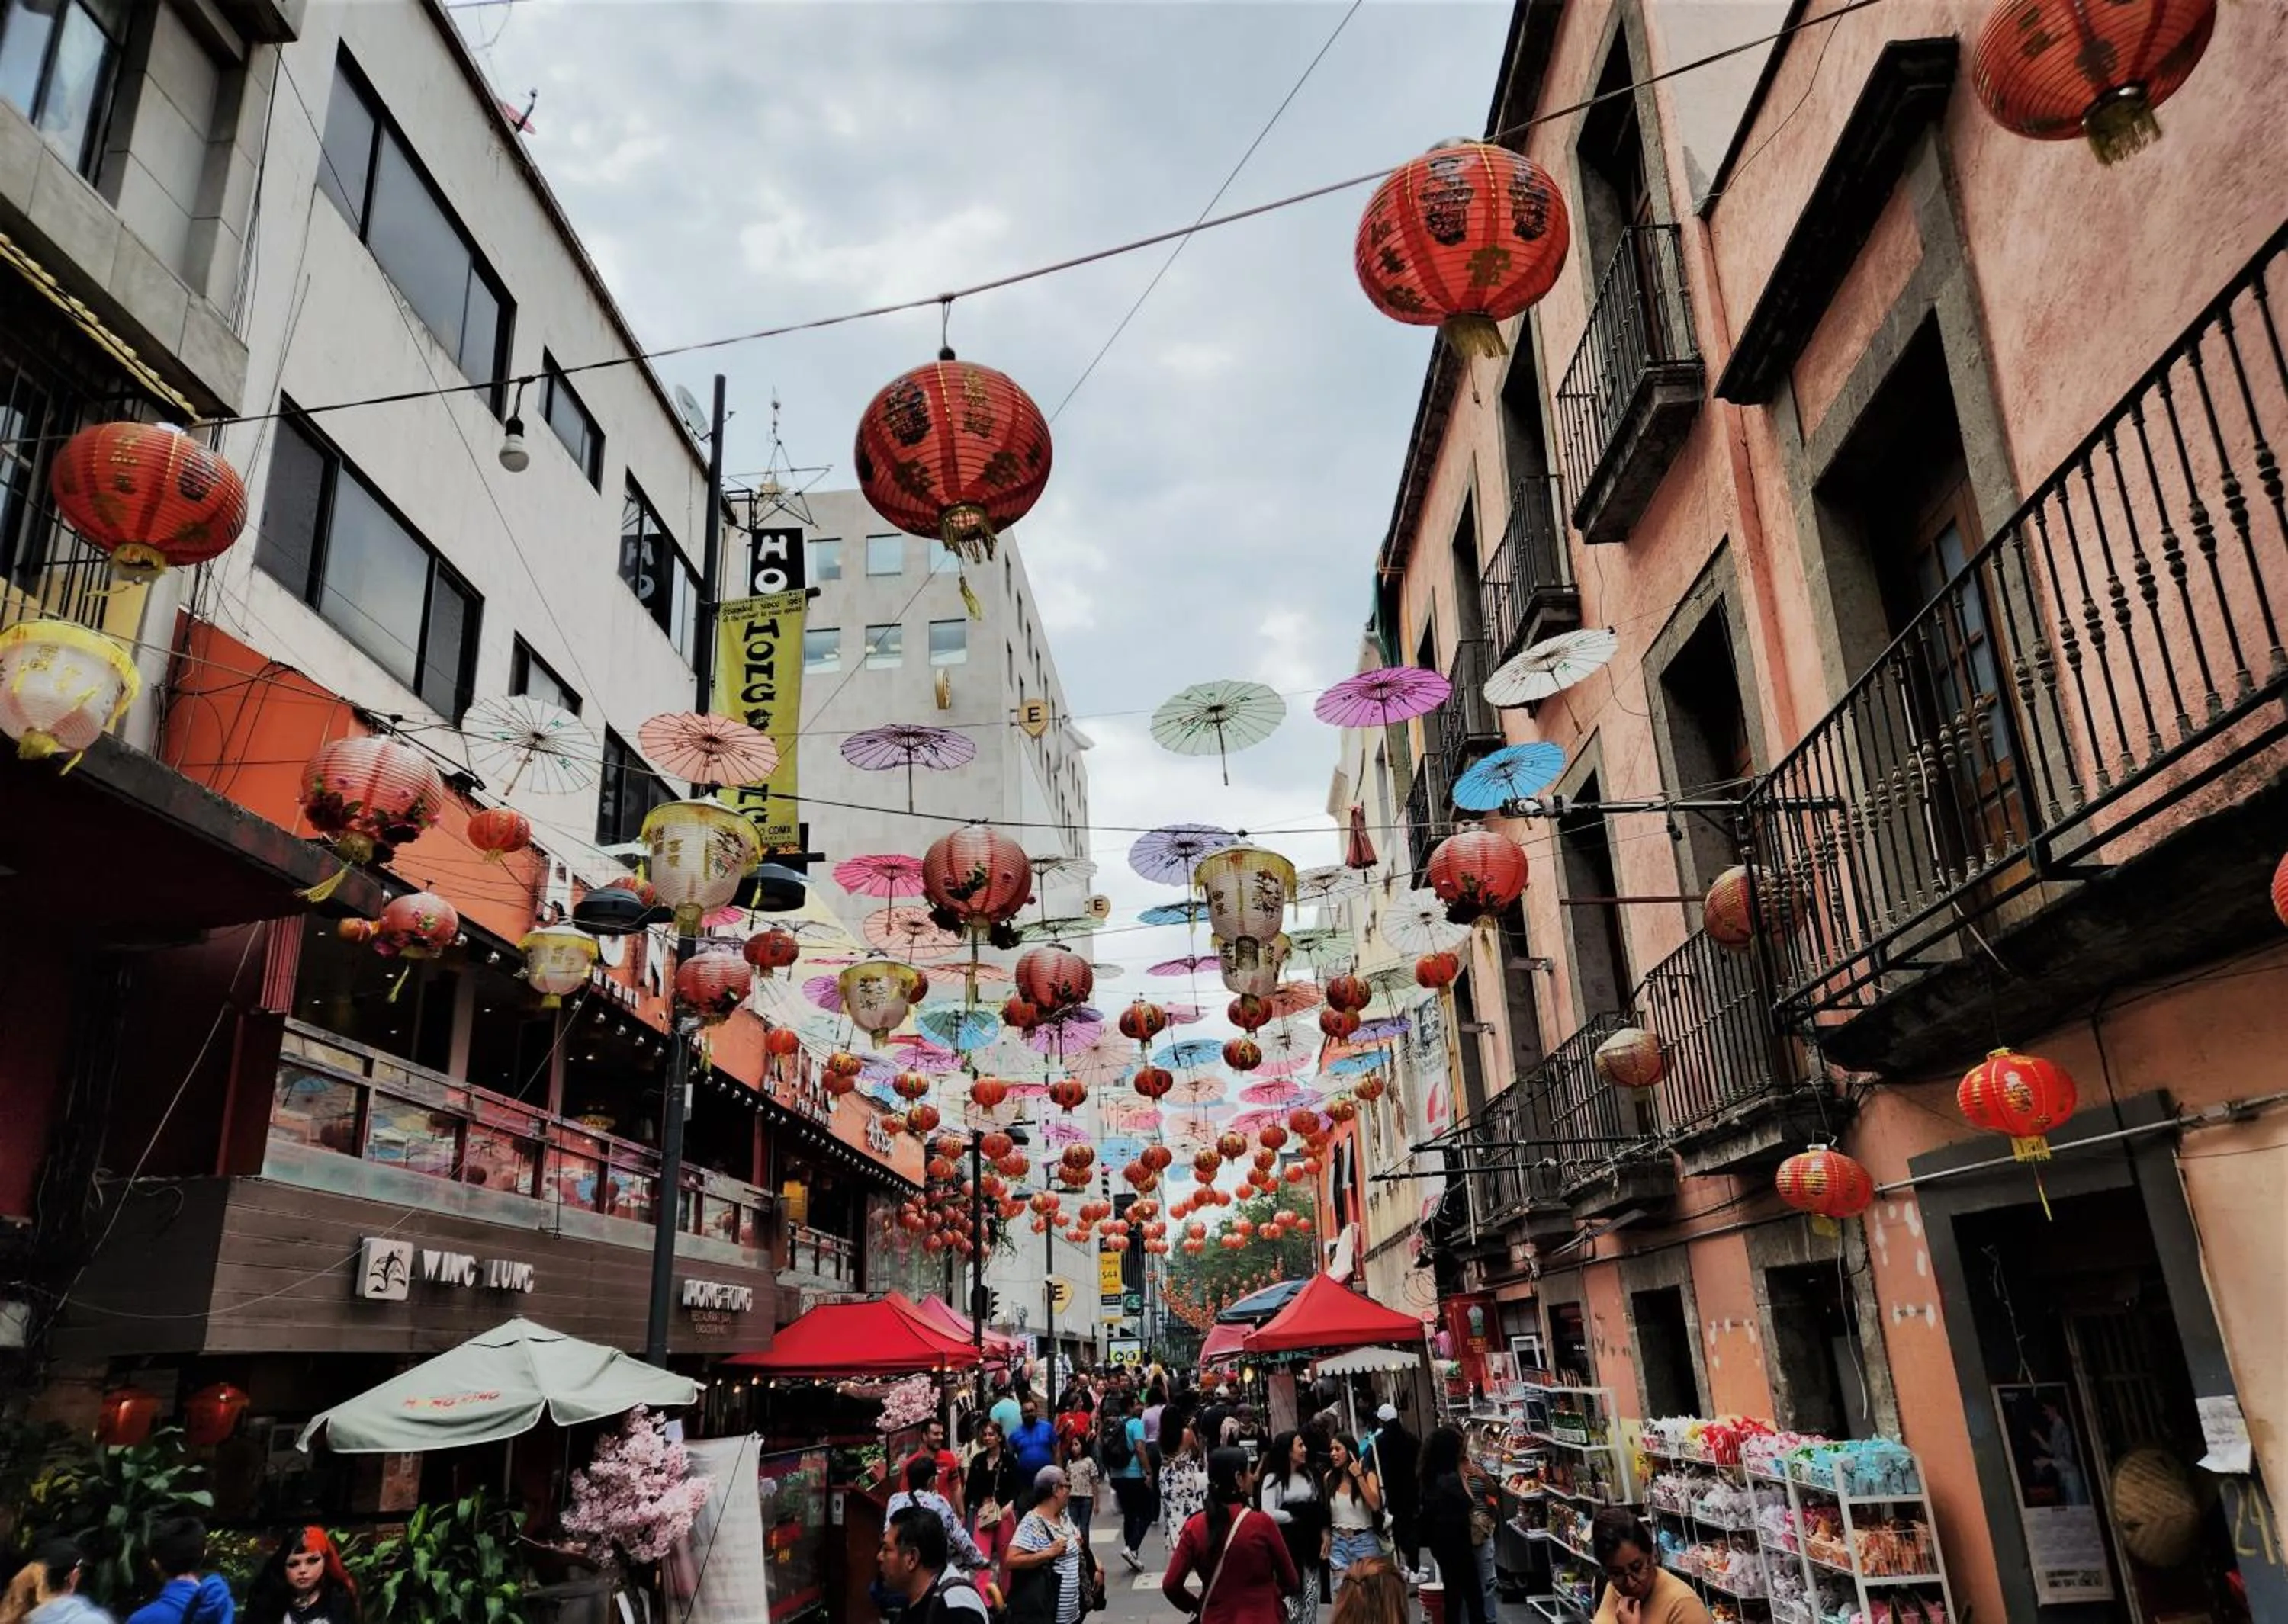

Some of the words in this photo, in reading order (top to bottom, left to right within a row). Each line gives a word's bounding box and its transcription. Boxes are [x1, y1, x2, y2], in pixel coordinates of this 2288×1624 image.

[1027, 707, 1041, 722] E
[768, 826, 792, 835] CDMX
[1094, 900, 1104, 910] E
[423, 1249, 477, 1288] WING
[490, 1259, 534, 1294] LUNG
